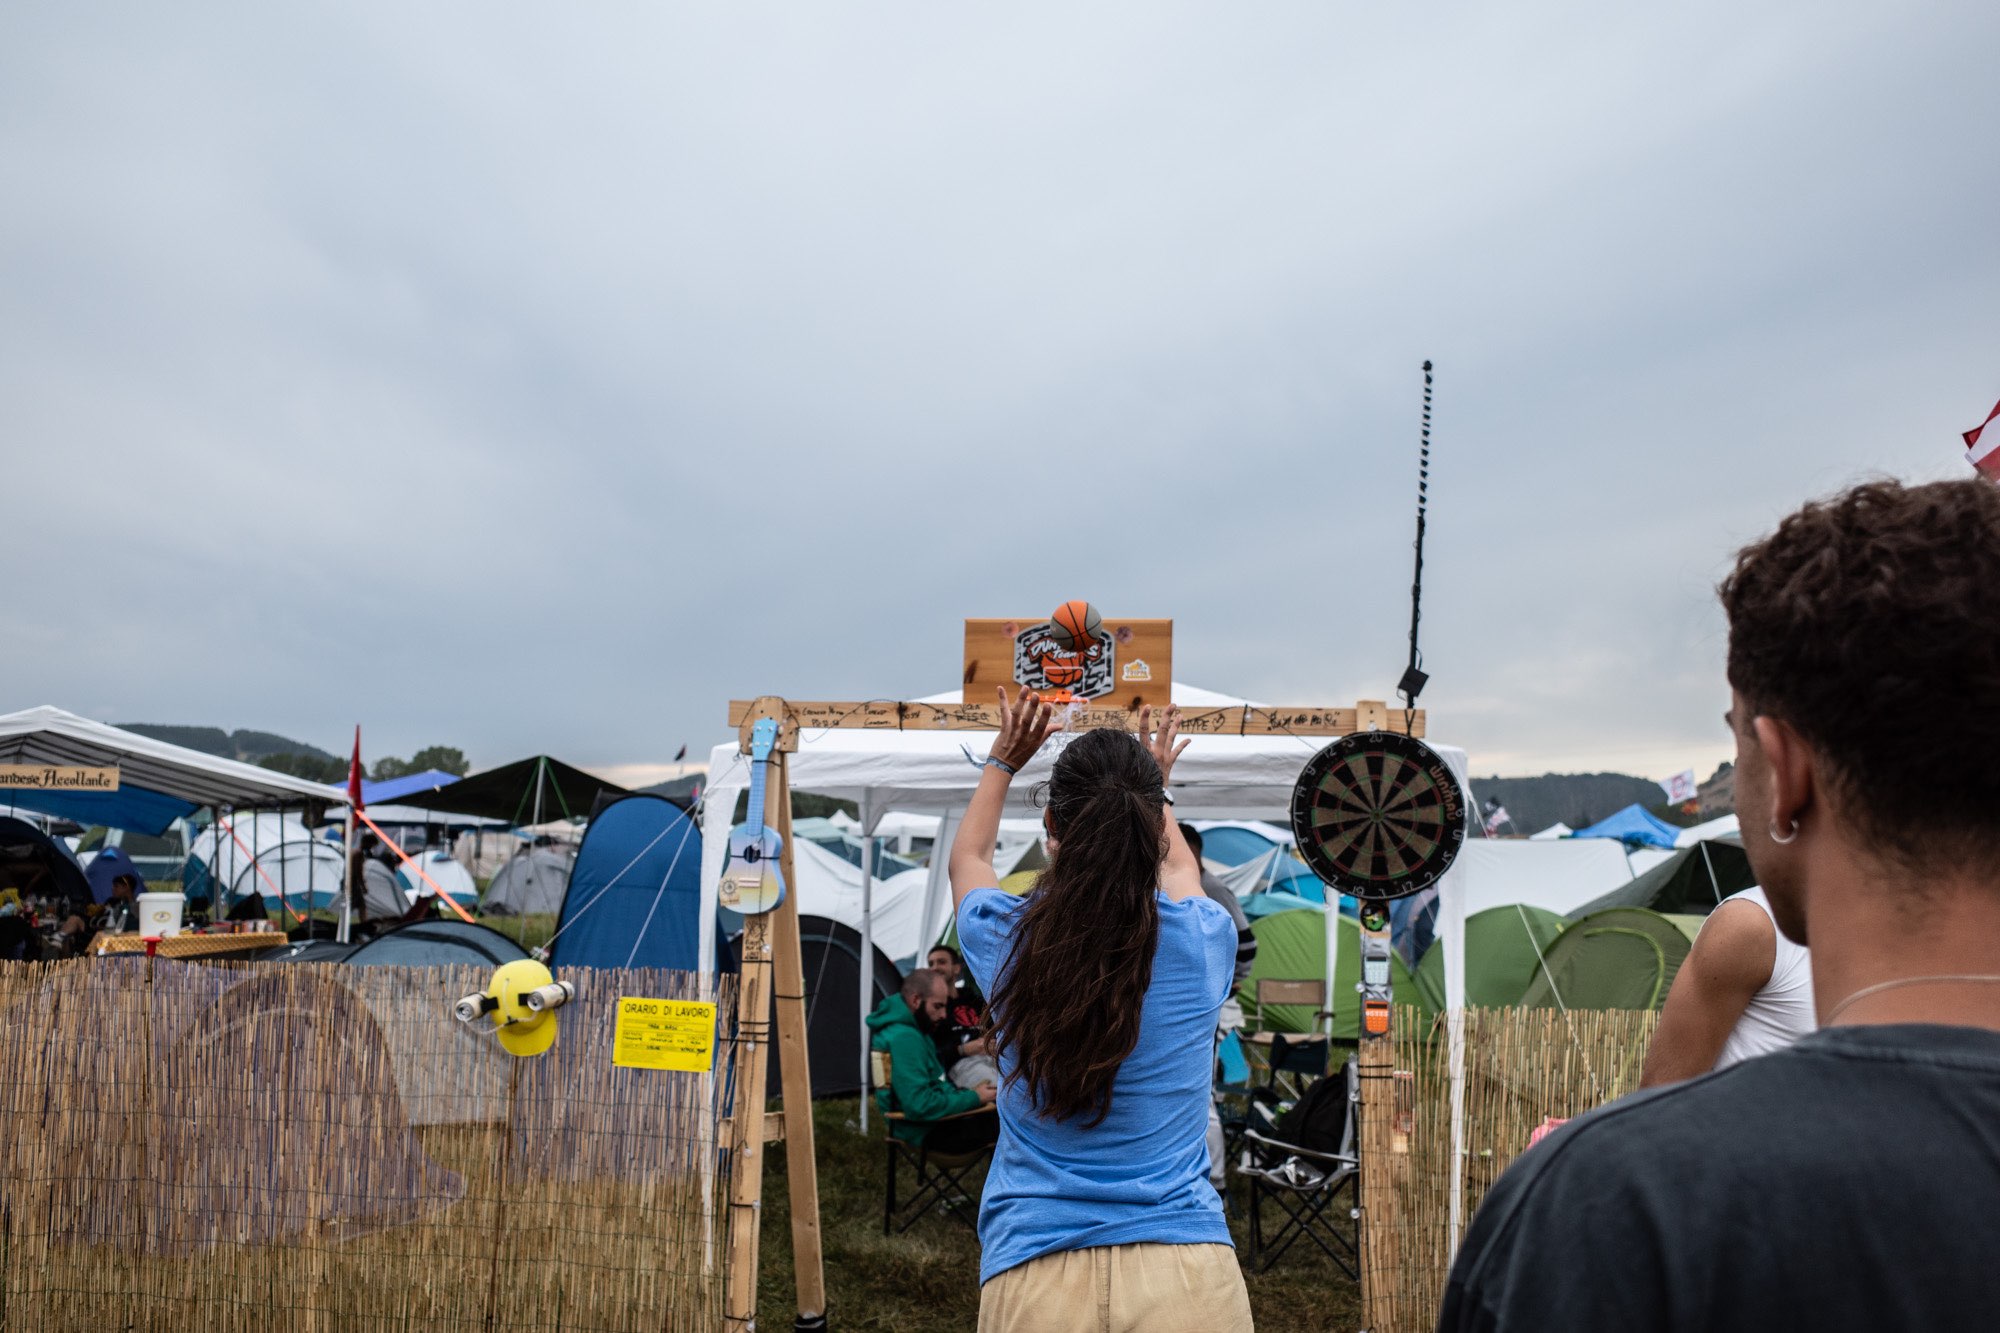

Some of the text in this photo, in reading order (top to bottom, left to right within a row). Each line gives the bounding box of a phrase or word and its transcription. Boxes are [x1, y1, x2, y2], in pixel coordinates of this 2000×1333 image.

[624, 1003, 710, 1018] ORARIO DI LAVORO
